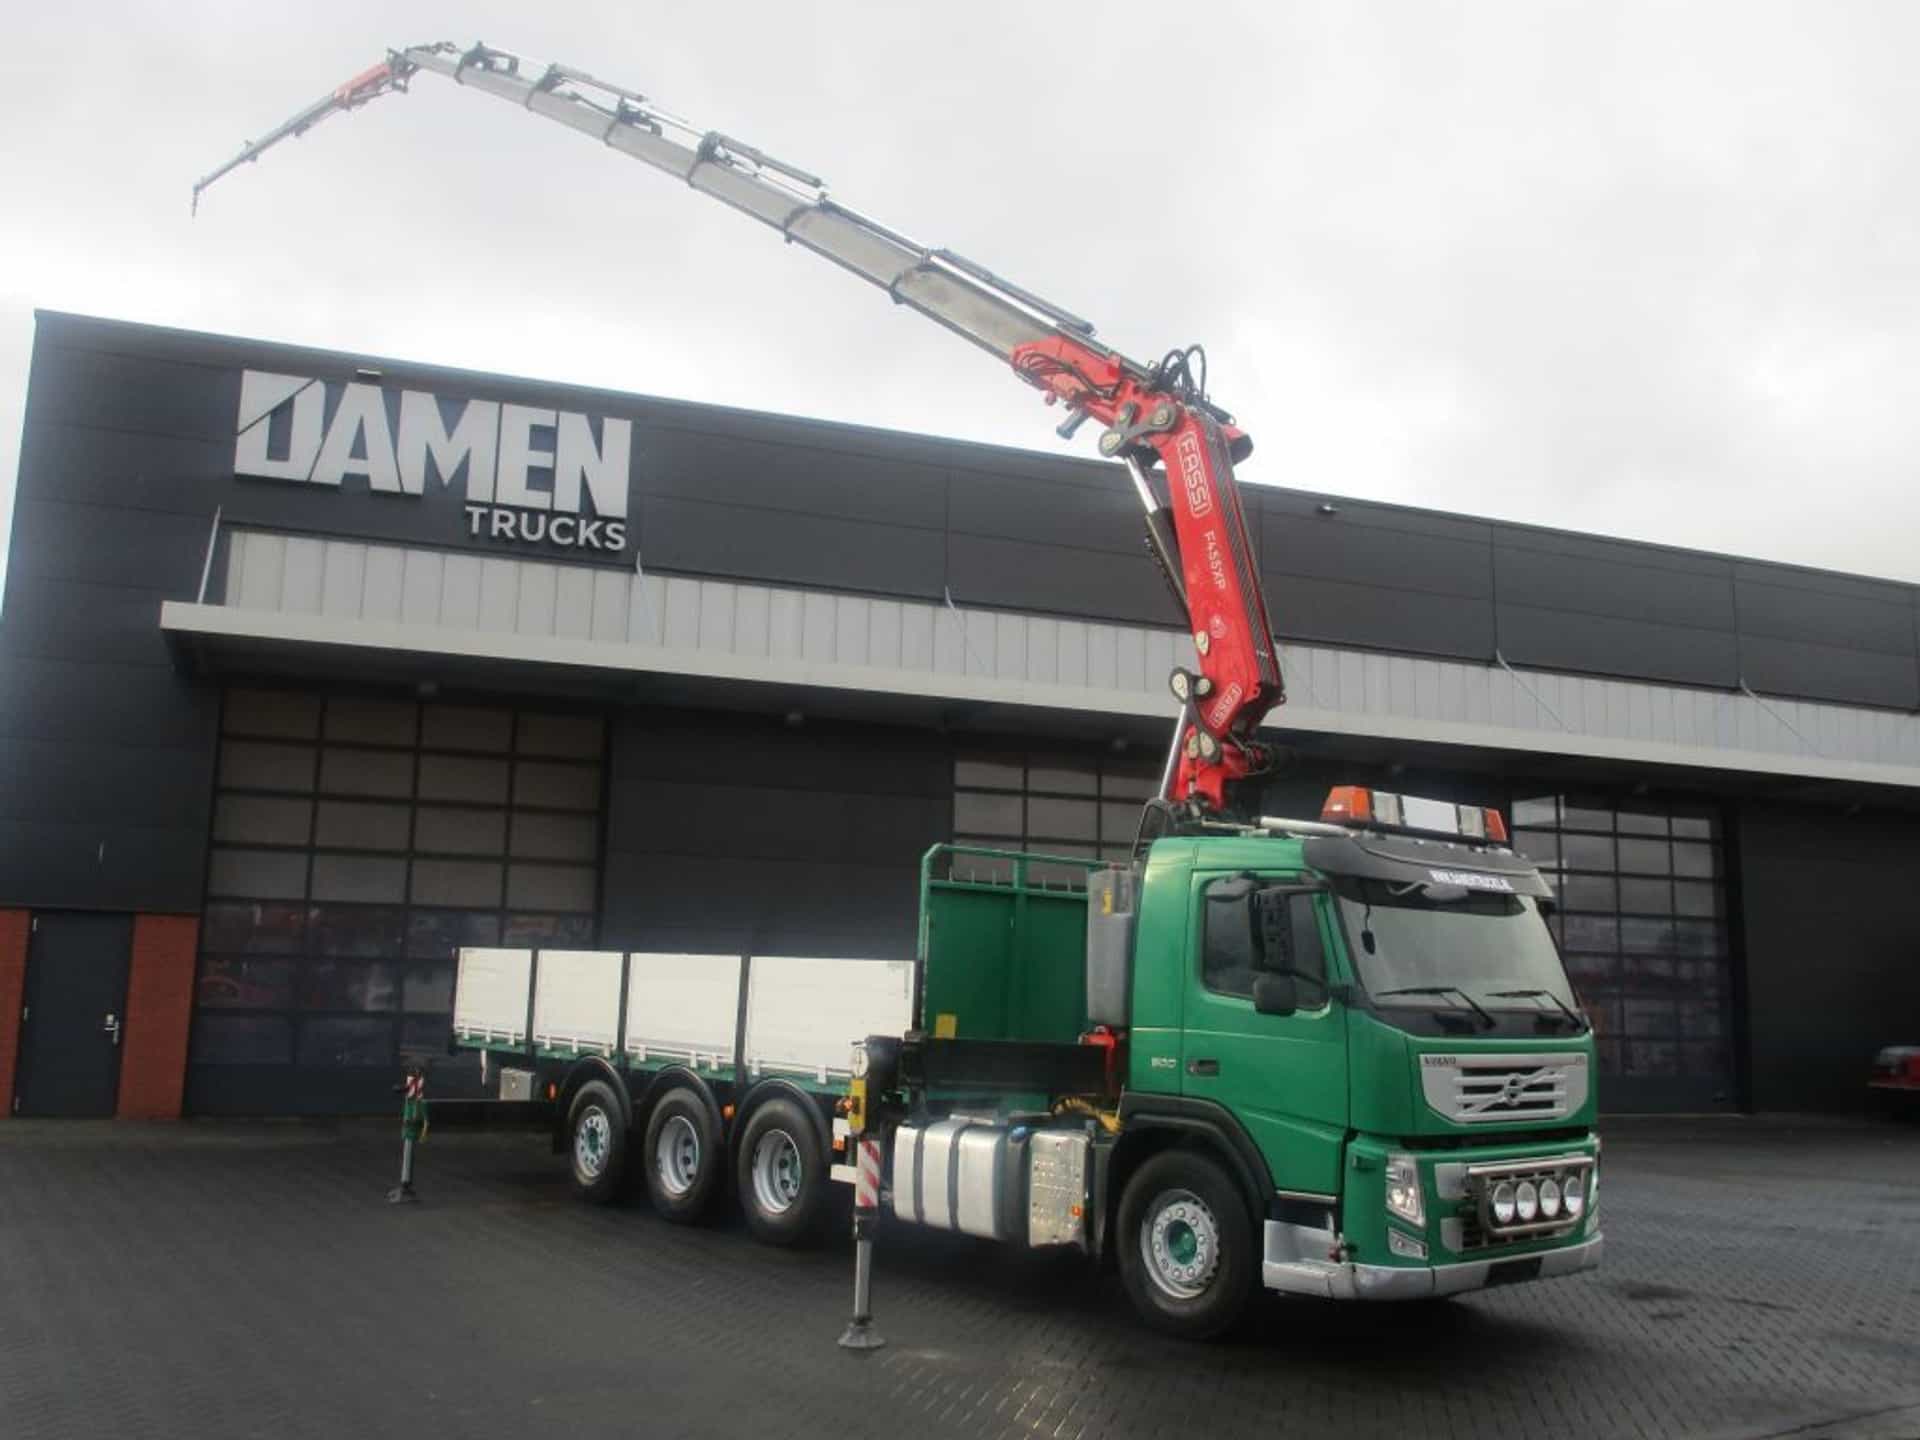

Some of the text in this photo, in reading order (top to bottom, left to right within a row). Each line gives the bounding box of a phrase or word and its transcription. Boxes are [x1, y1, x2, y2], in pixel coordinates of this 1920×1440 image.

[234, 370, 632, 519] DAMEN
[1179, 435, 1210, 517] FASSI
[465, 505, 626, 552] TRUCKS
